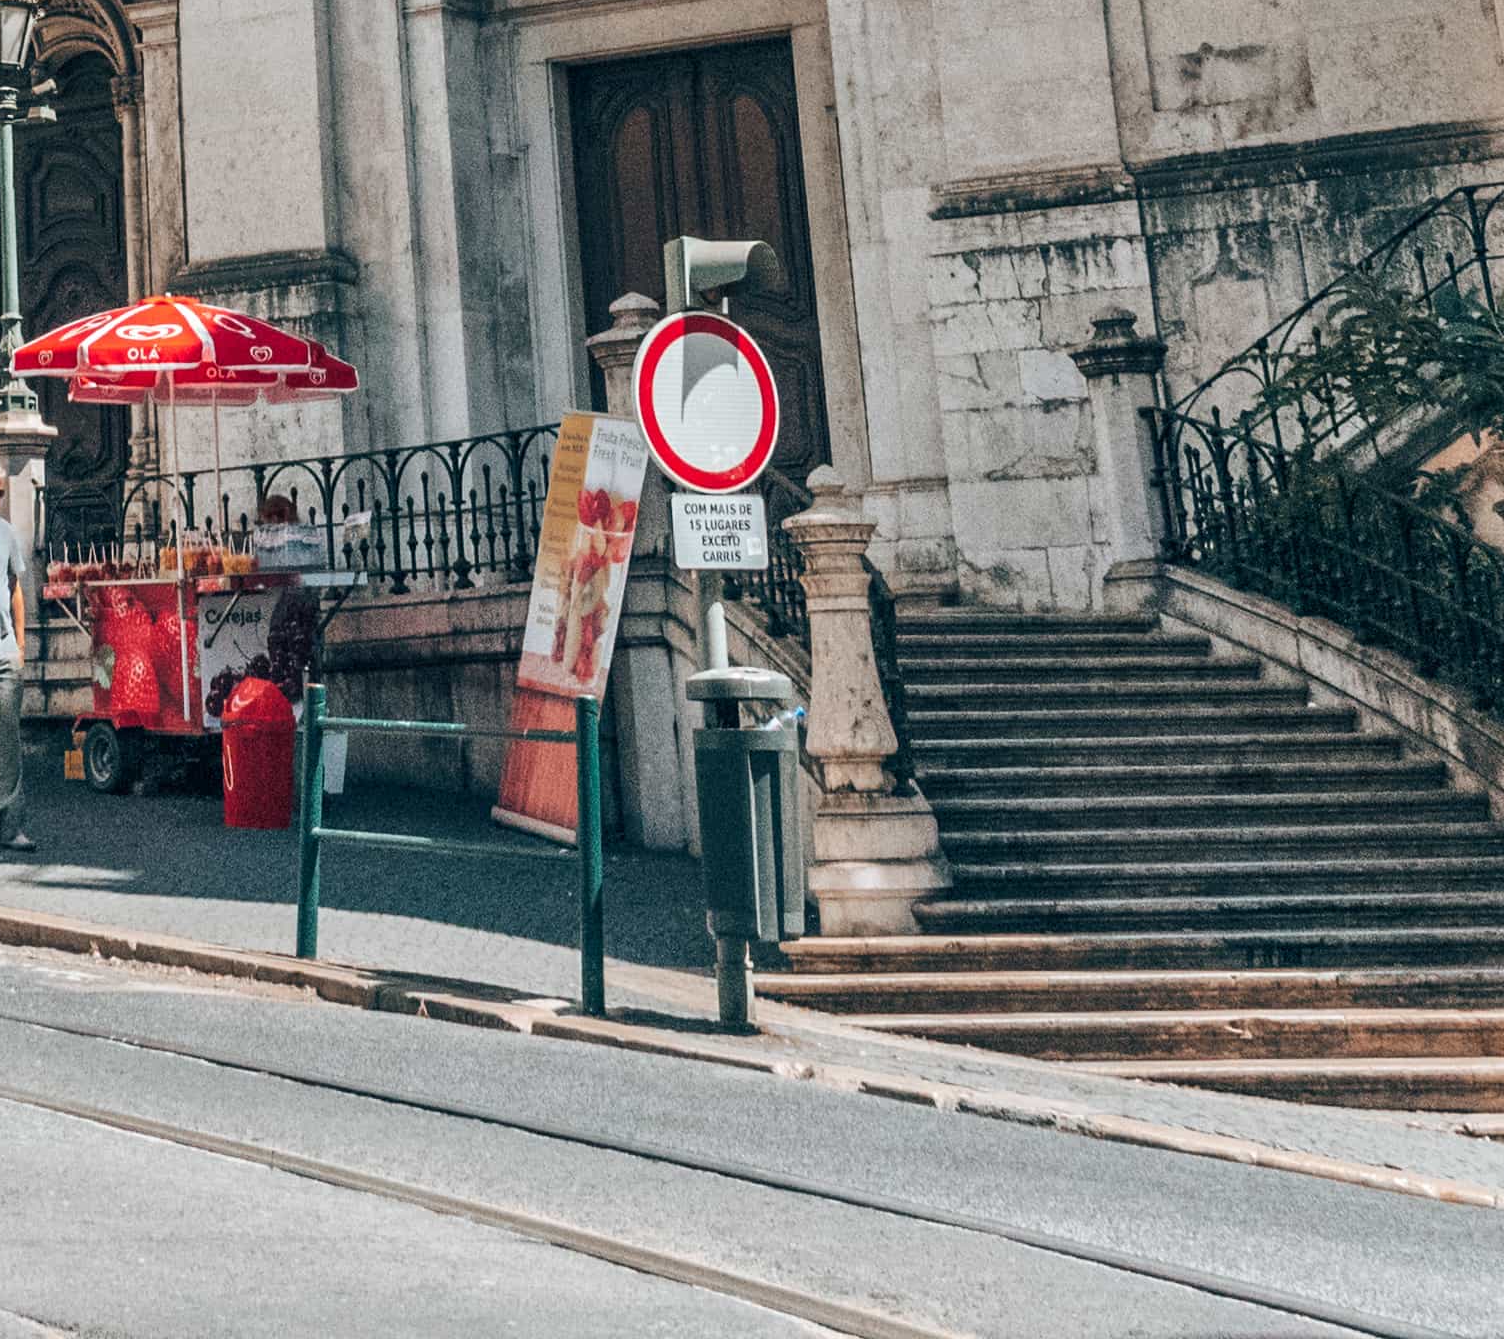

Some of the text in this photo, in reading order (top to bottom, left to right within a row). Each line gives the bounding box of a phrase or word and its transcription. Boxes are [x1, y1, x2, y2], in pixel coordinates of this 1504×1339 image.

[127, 344, 161, 361] OLÁ
[684, 503, 752, 516] COM MAIS DE
[689, 519, 751, 532] 15 LUGARES
[701, 534, 741, 547] EXCETO
[702, 550, 742, 563] CARRIS
